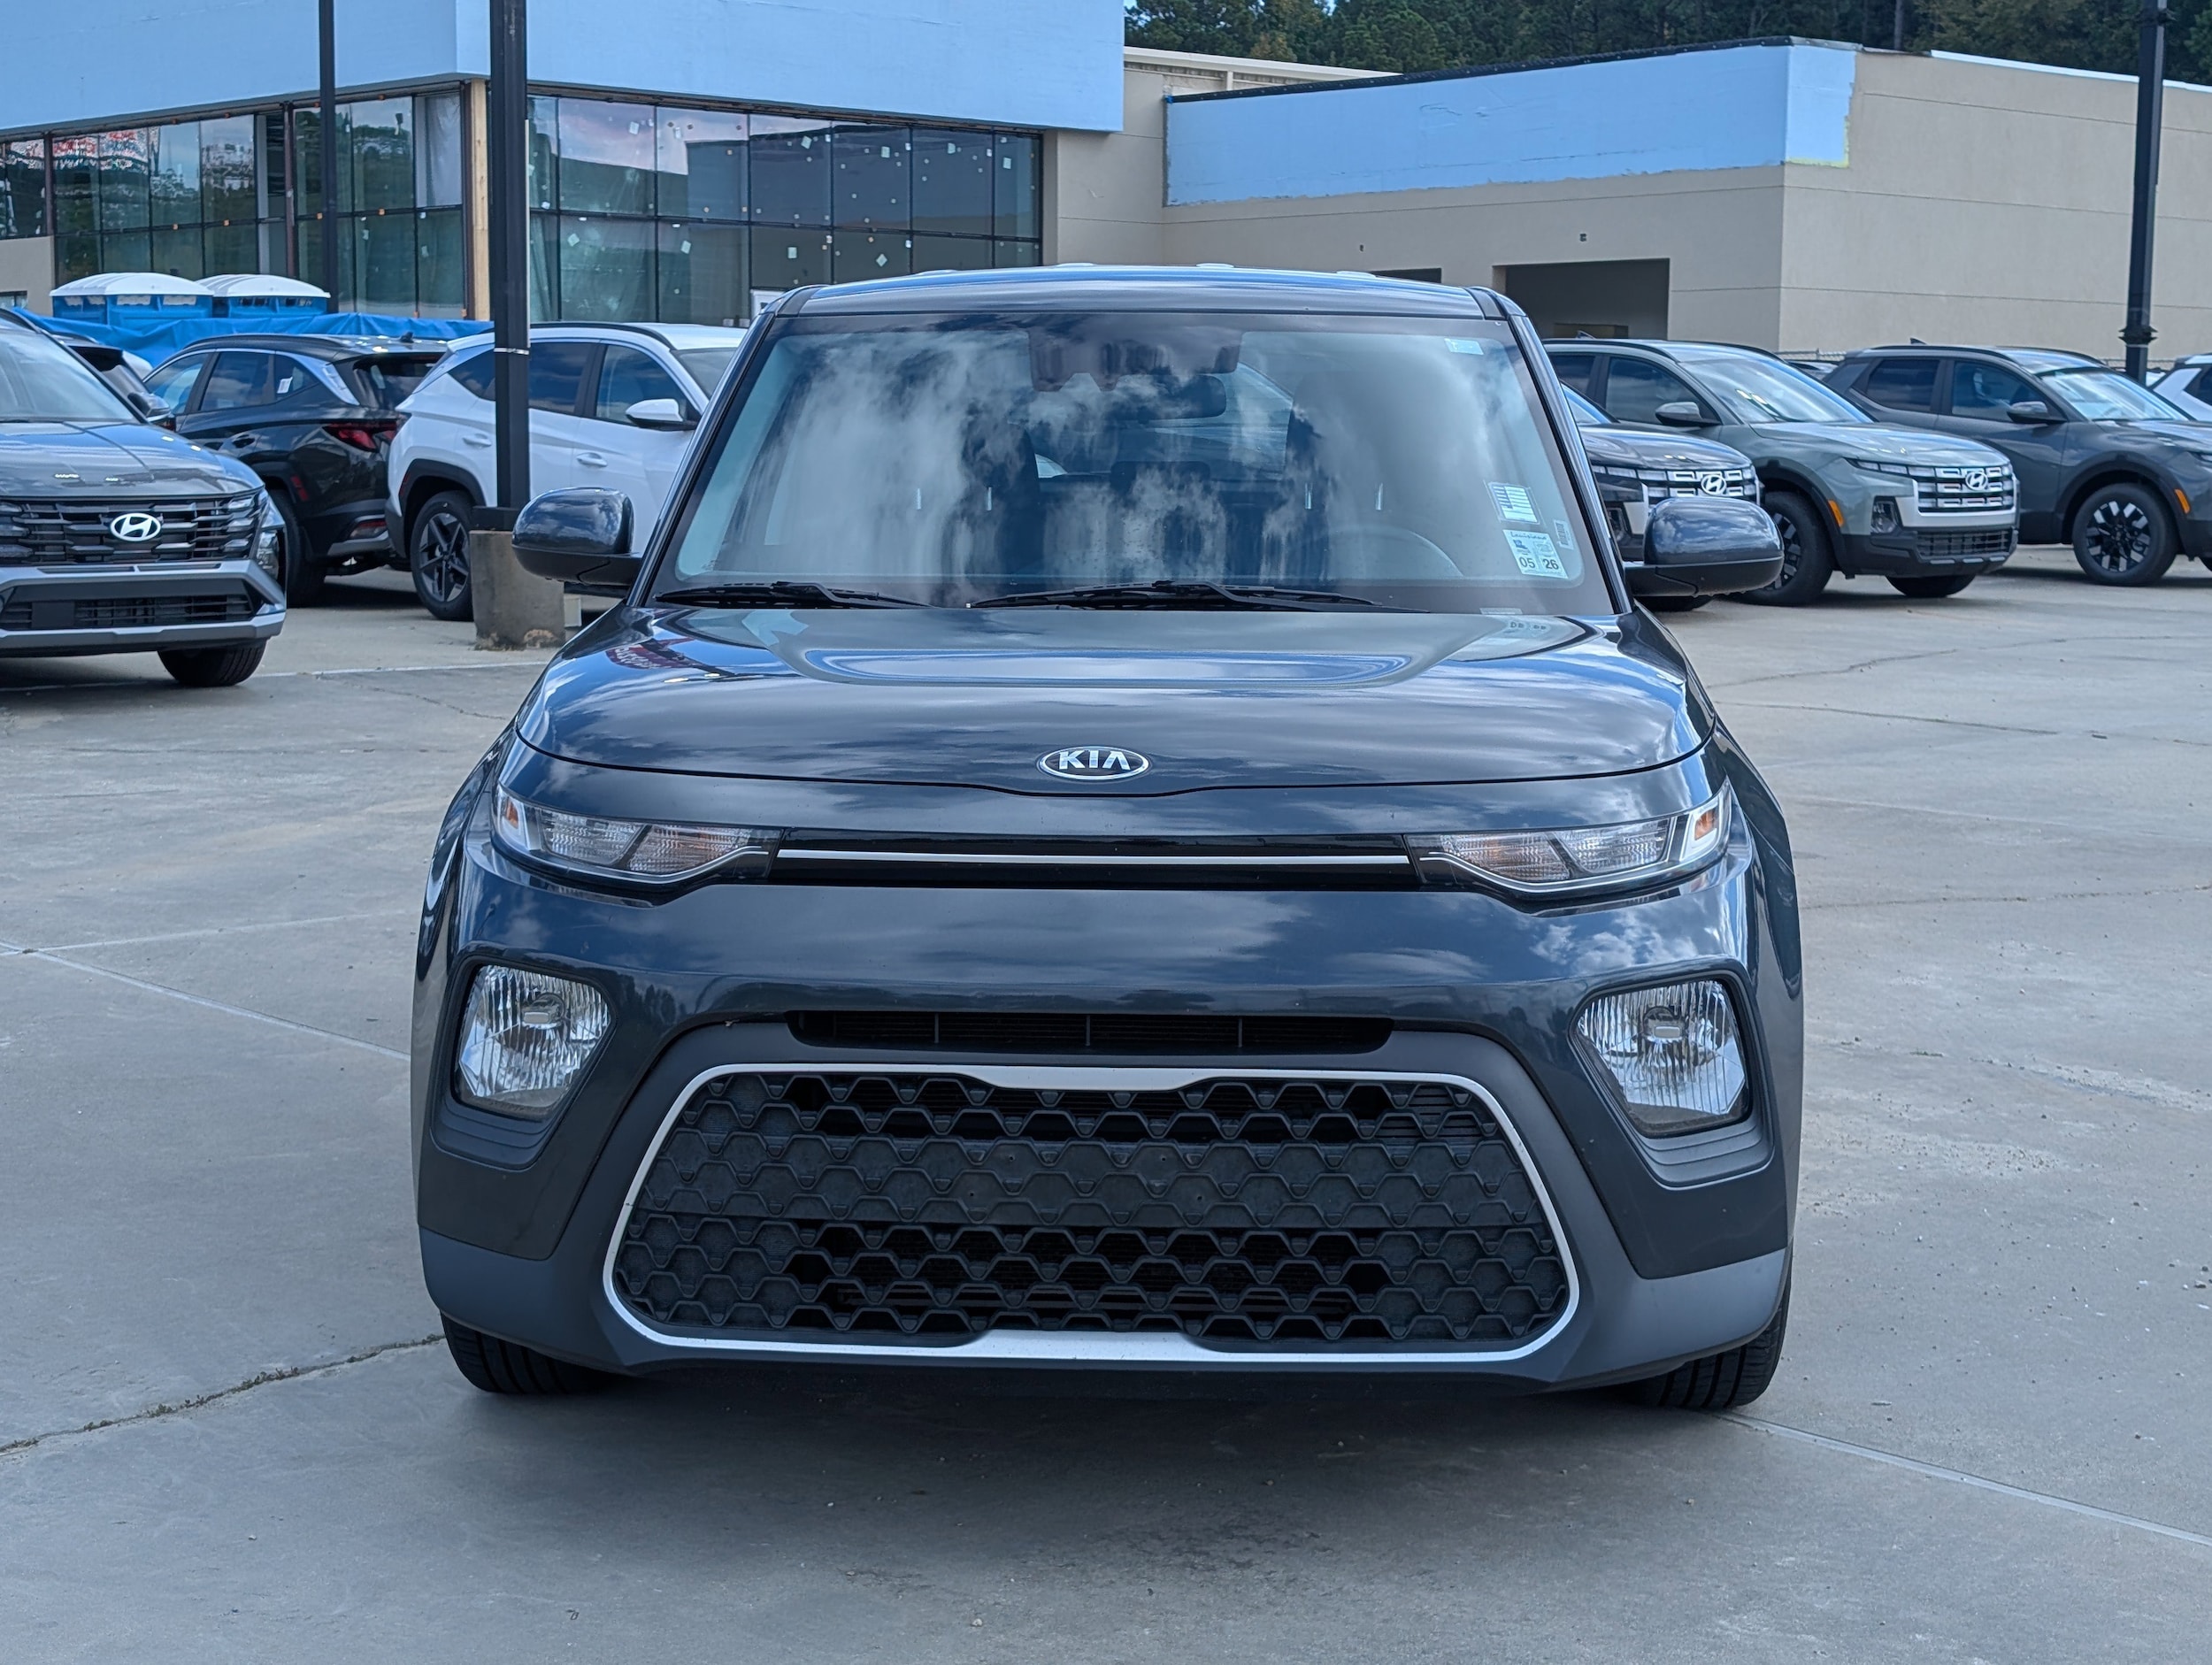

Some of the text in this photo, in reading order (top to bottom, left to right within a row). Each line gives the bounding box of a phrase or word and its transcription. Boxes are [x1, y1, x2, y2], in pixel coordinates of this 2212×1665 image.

[1519, 557, 1559, 570] 05 26
[1058, 749, 1131, 771] KIA
